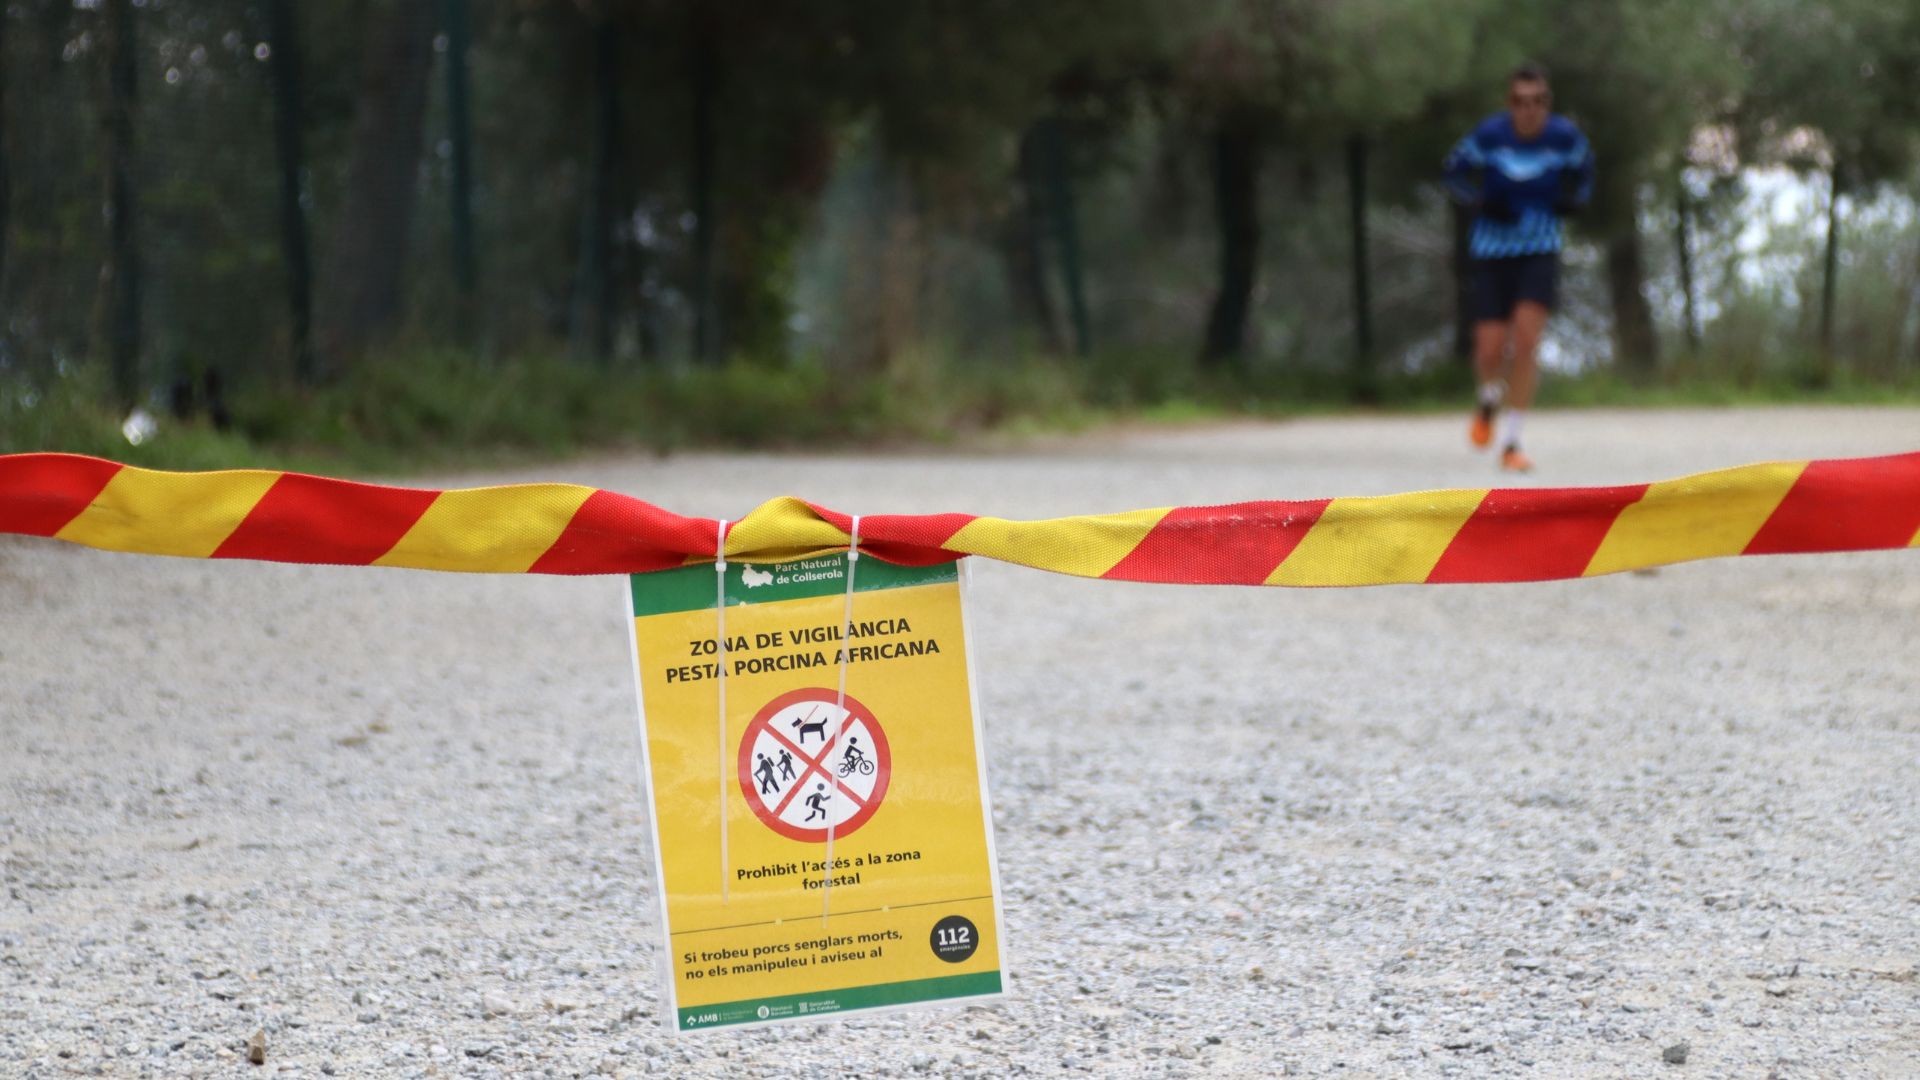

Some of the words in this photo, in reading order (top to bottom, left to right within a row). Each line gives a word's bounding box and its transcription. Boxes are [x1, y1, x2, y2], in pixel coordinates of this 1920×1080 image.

[775, 563, 798, 572] Parc
[801, 557, 842, 570] Natural
[777, 575, 790, 585] de
[792, 569, 843, 583] Collserola
[690, 635, 750, 656] ZONA
[756, 632, 783, 649] DE
[789, 618, 912, 645] VIGILÀNCIA
[666, 663, 728, 683] PESTA
[734, 651, 827, 676] PORCINA
[834, 639, 940, 665] AFRICANA
[737, 863, 797, 880] Prohibit
[855, 857, 864, 866] a
[868, 853, 882, 865] la
[886, 851, 921, 863] zona
[802, 872, 861, 890] forestal
[684, 952, 697, 964] Si
[701, 948, 749, 962] trobeu
[753, 943, 790, 958] porcs
[795, 936, 853, 951] senglars
[857, 930, 903, 943] morts,
[938, 926, 970, 946] 112
[686, 970, 704, 979] no
[708, 965, 728, 976] els
[732, 957, 808, 974] manipuleu
[812, 954, 816, 965] i
[820, 950, 866, 963] aviseu
[870, 946, 882, 957] al
[698, 1012, 718, 1024] AMB
